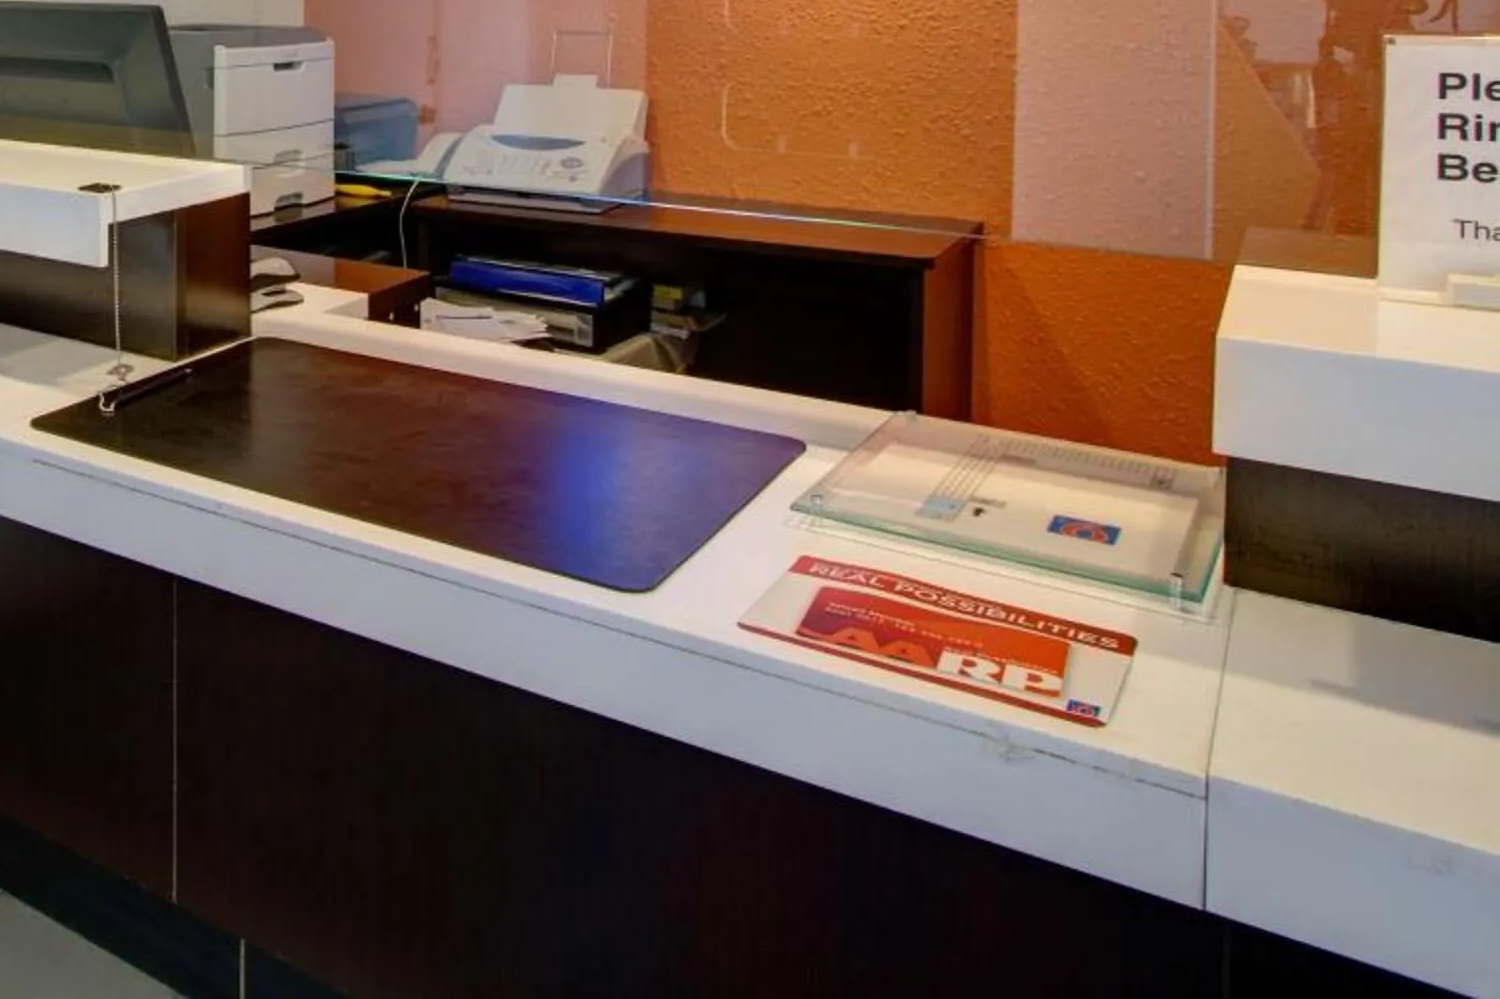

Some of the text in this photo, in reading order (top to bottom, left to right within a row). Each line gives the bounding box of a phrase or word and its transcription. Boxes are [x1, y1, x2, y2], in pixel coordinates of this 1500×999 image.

[1437, 154, 1499, 183] Be
[808, 562, 885, 589] REAL
[898, 579, 1121, 650] POSSIBILITIES
[822, 627, 1064, 697] AARP
